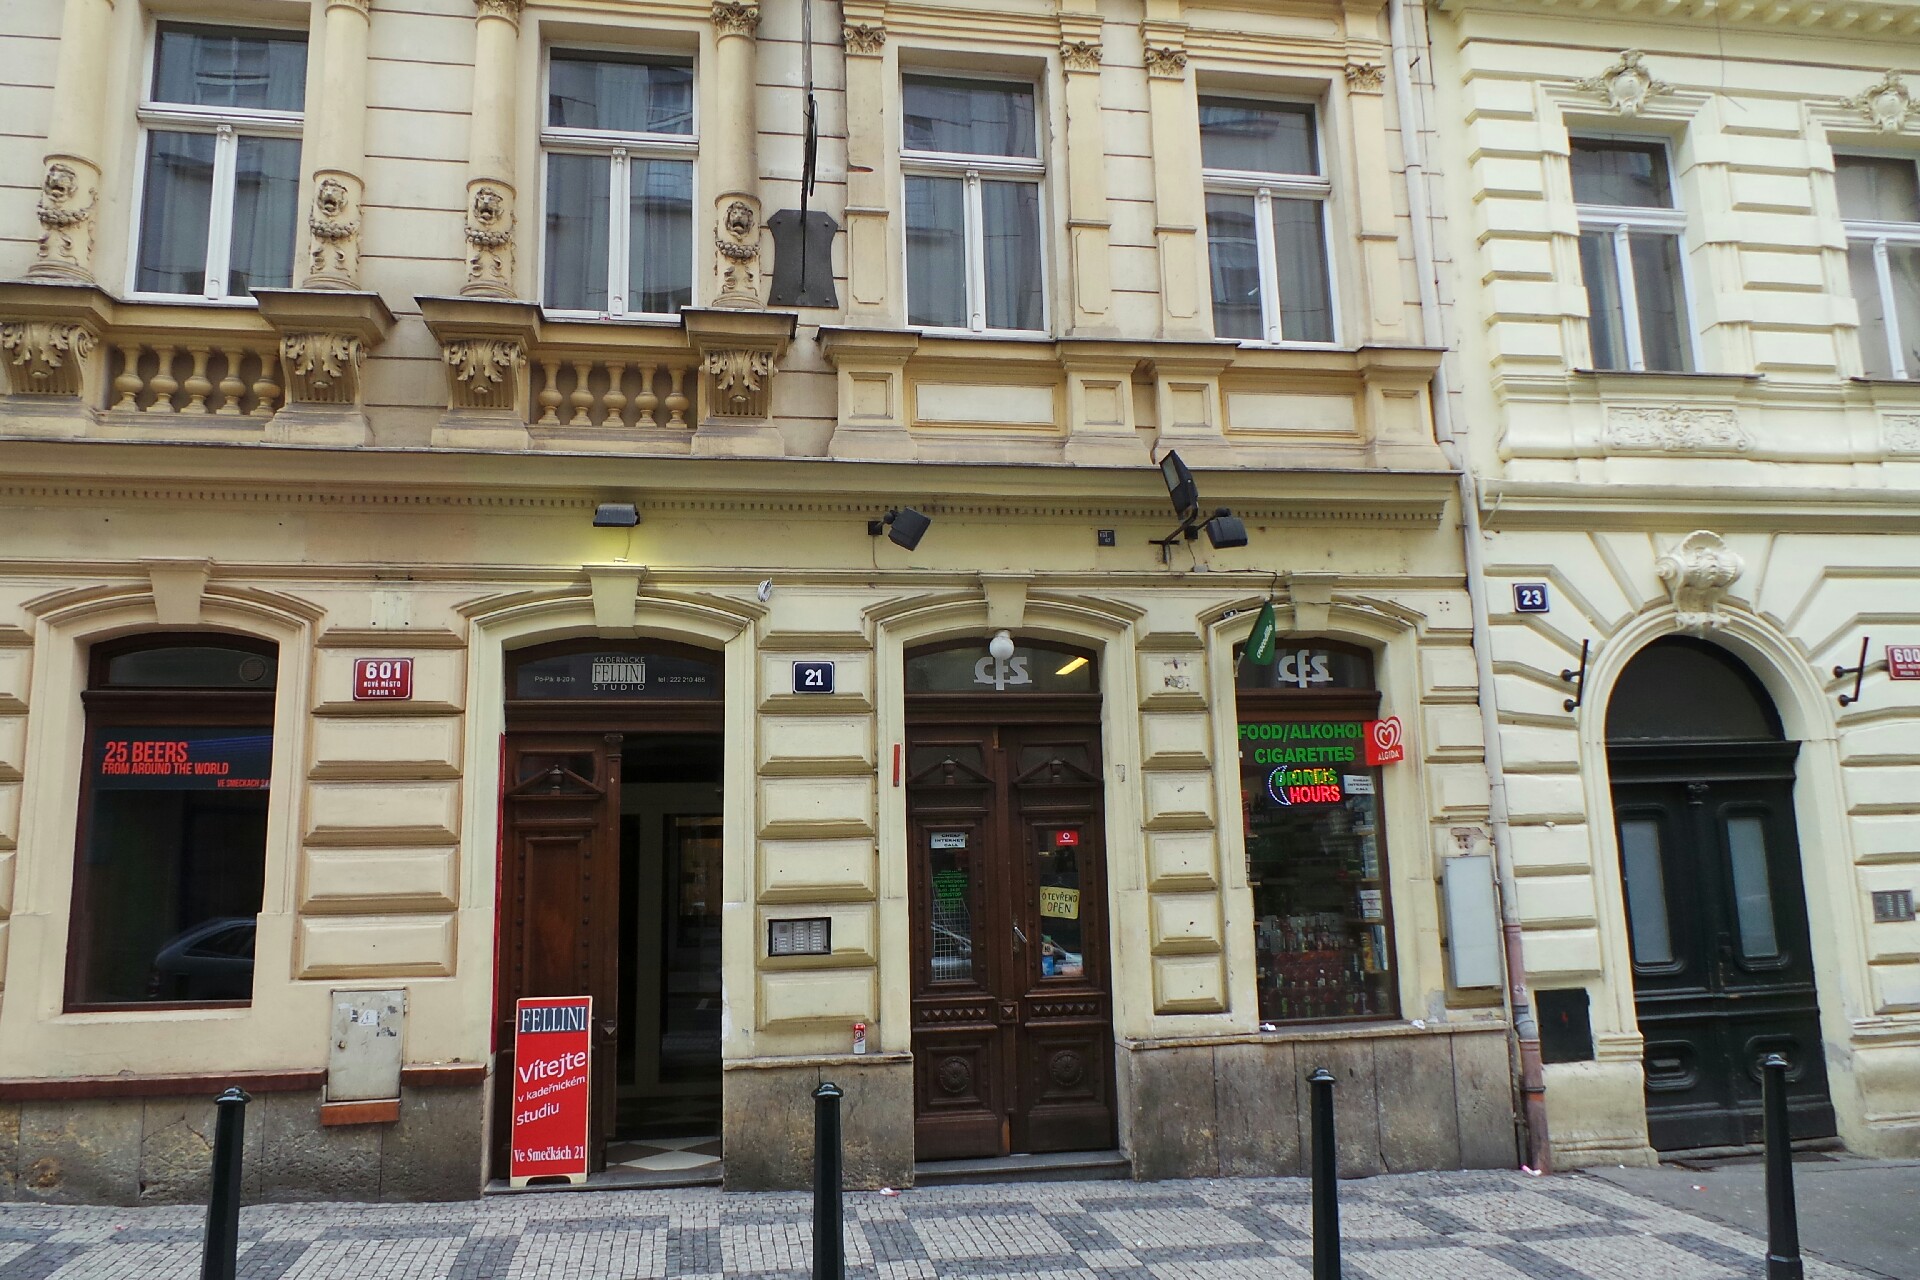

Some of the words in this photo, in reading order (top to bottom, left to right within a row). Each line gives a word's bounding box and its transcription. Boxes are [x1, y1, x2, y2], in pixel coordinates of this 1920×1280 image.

[1521, 590, 1542, 605] 23
[365, 661, 401, 679] 601
[594, 664, 644, 682] FELLINI
[805, 668, 824, 686] 21
[593, 683, 645, 691] STUDIO
[104, 741, 128, 763] 25
[131, 742, 189, 763] BEERS
[1254, 746, 1355, 763] CIGARETTES
[1378, 749, 1400, 760] ALGIDA
[102, 762, 128, 775] FROM
[131, 762, 171, 775] AROUND
[174, 762, 192, 775] THE
[194, 762, 229, 775] WORLD
[1289, 785, 1340, 803] HOURS
[1047, 902, 1071, 914] OPEN
[520, 1006, 586, 1033] FELLINI
[518, 1051, 586, 1084] Vítejte
[517, 1095, 525, 1103] v
[526, 1076, 586, 1101] kadeřnickém
[516, 1102, 560, 1126] studiu
[514, 1149, 525, 1162] Ve
[527, 1145, 572, 1162] Smečkách
[573, 1145, 585, 1160] 21
